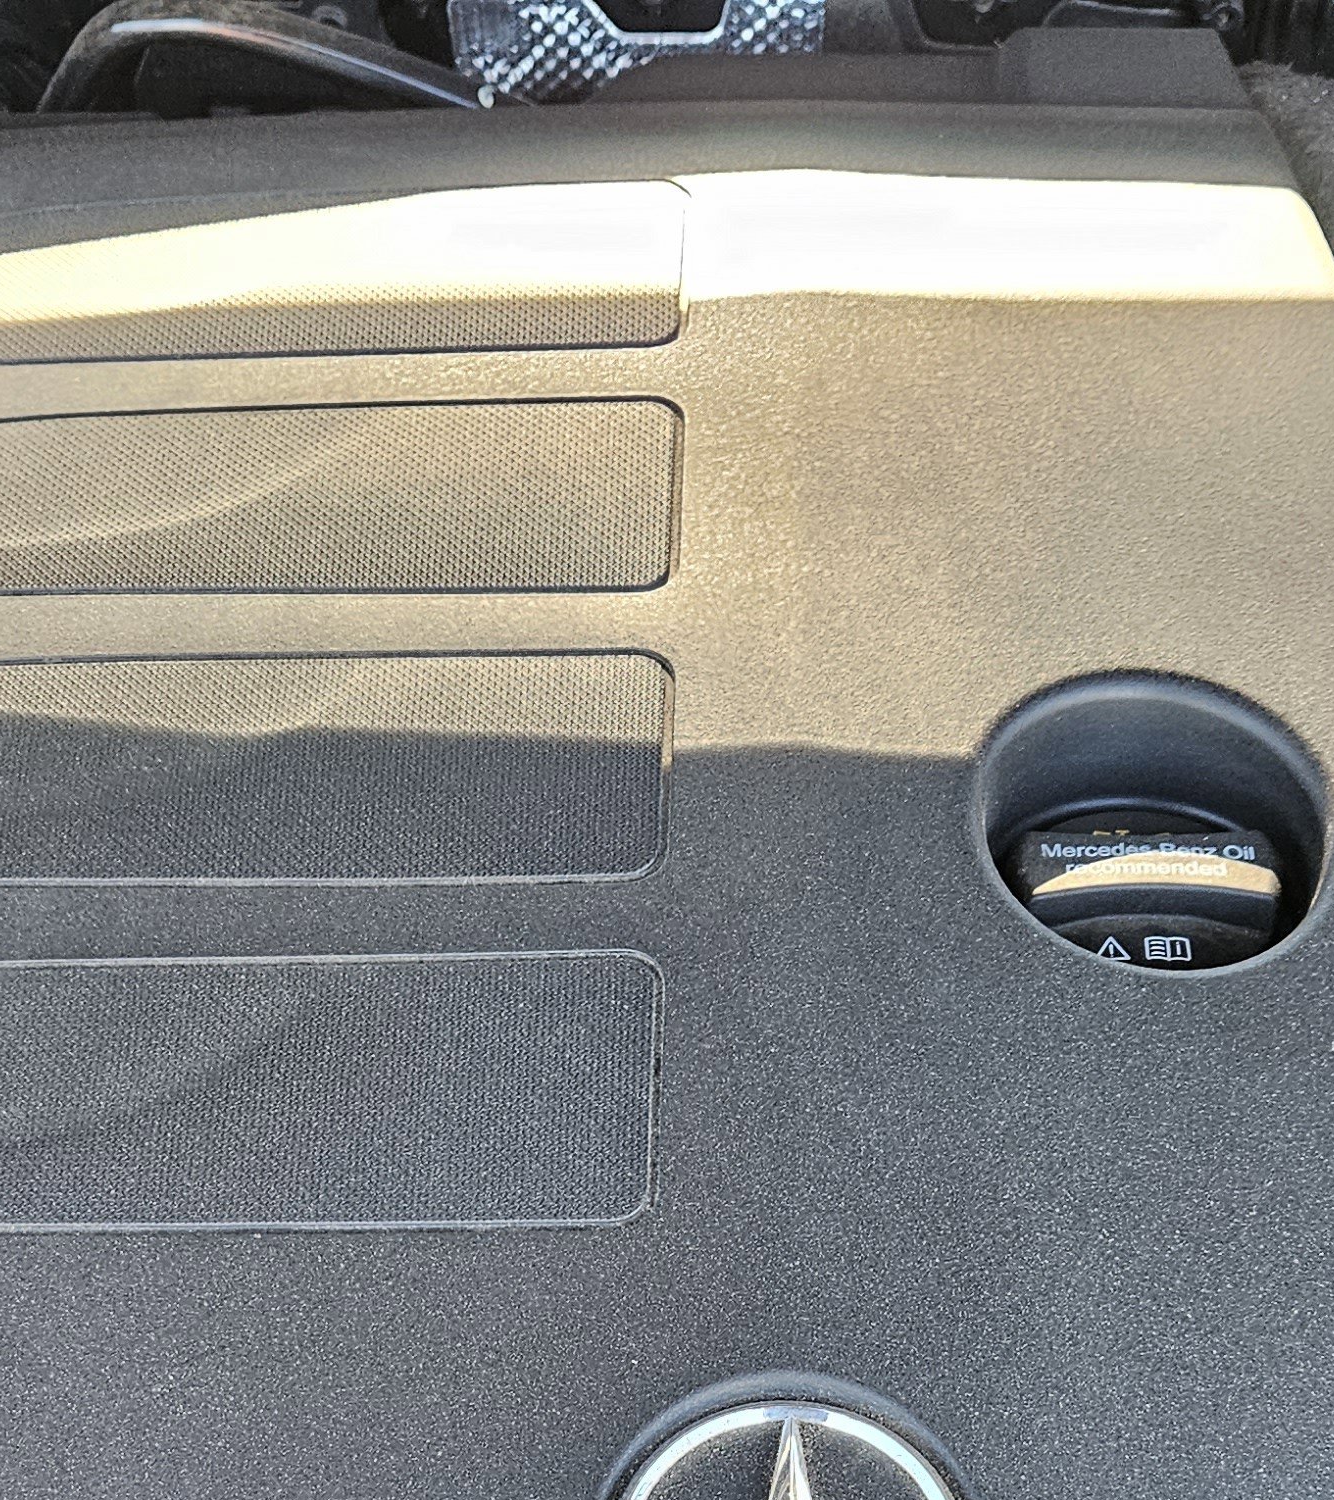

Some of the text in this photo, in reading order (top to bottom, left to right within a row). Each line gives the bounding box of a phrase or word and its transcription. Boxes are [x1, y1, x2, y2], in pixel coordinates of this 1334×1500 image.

[1041, 842, 1256, 861] Mercedes-Benz Oil
[1065, 860, 1229, 877] recommended
